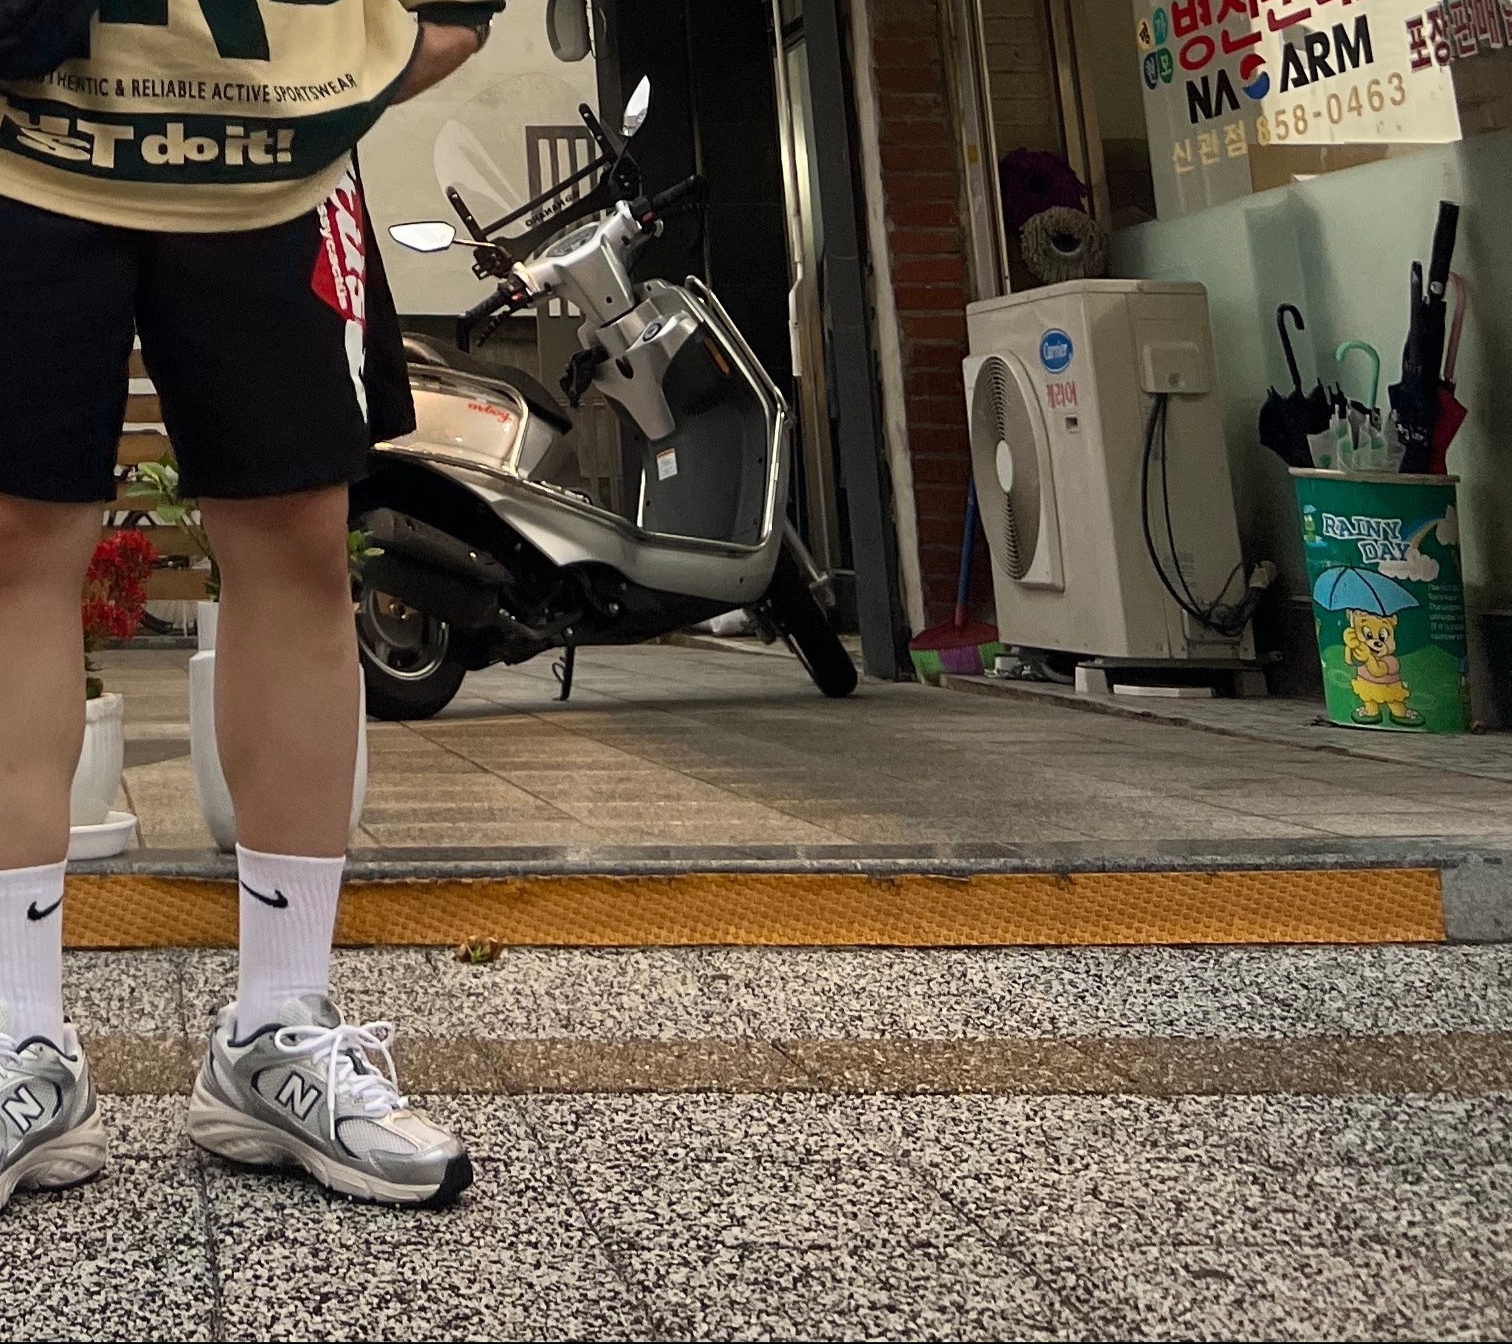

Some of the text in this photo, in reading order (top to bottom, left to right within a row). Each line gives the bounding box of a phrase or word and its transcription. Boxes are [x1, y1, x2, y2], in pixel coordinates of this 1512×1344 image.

[115, 80, 125, 97] &
[132, 80, 206, 100] RELIABLE
[211, 86, 270, 102] ACTIVE
[274, 72, 358, 104] SPORTSWEAR
[1172, 71, 1407, 174] 신관점 858-0463
[140, 122, 219, 165] do
[224, 124, 295, 166] it!
[1322, 513, 1402, 541] RAINY
[1358, 540, 1411, 564] DAY
